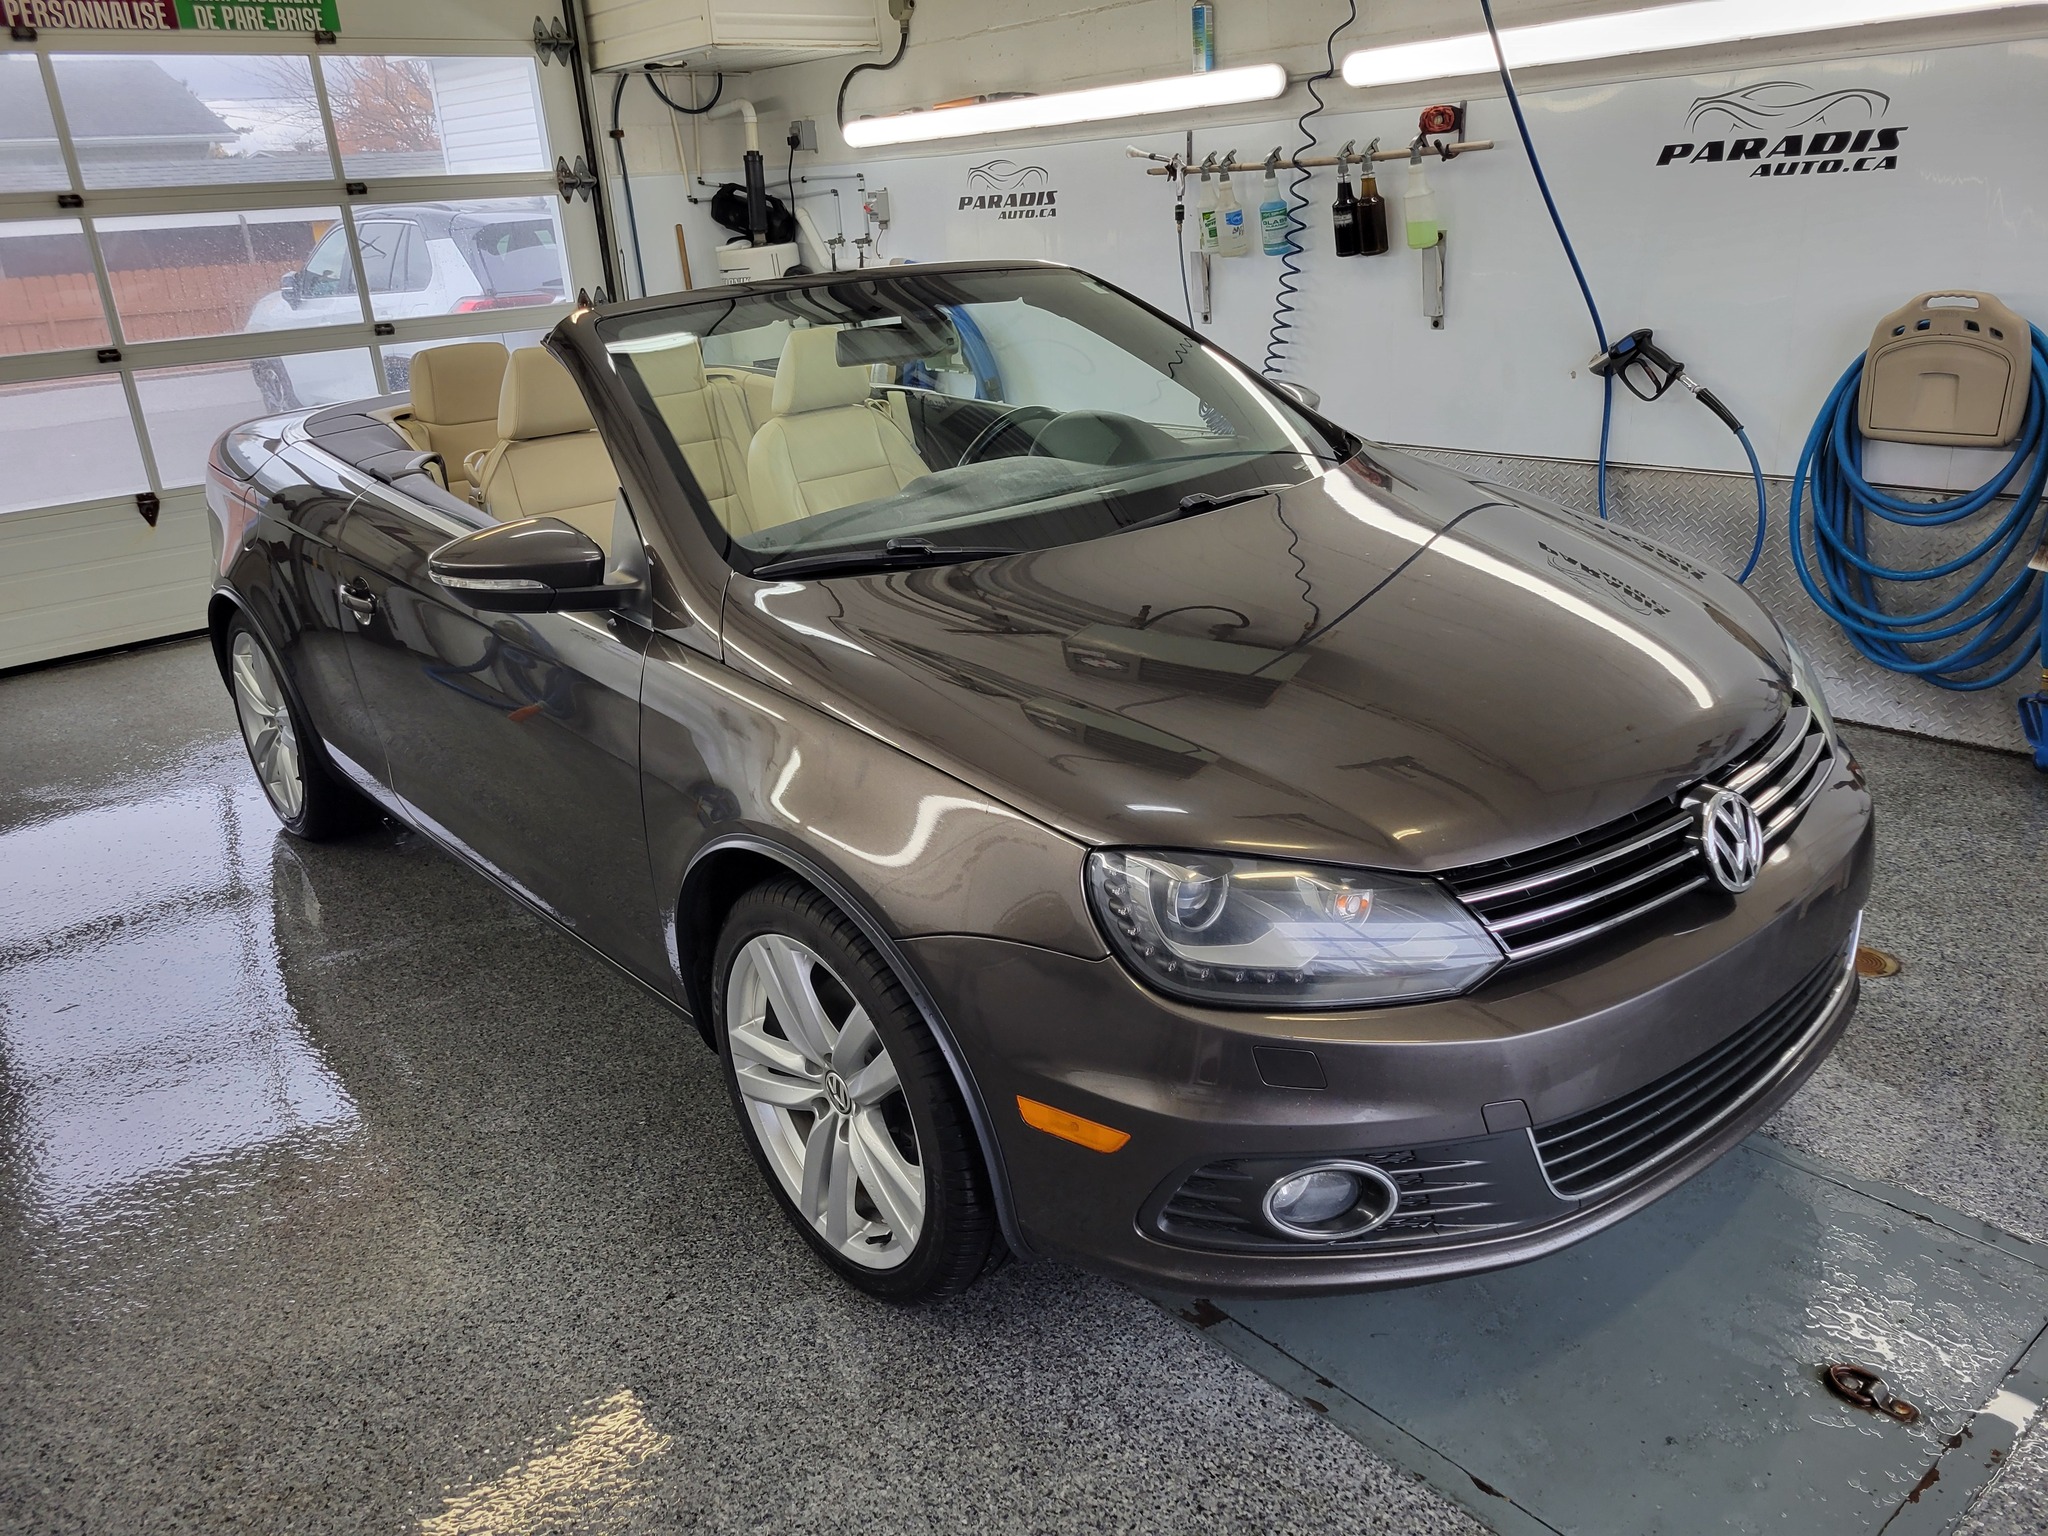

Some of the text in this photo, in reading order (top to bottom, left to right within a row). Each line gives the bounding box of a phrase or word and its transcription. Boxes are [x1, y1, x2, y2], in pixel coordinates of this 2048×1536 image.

[193, 5, 326, 32] DE PARE-BRISE
[1656, 126, 1909, 166] PARADIS
[1749, 155, 1898, 178] AUTO.CA
[958, 190, 1058, 211] PARADIS
[998, 208, 1057, 220] AUTO.CA
